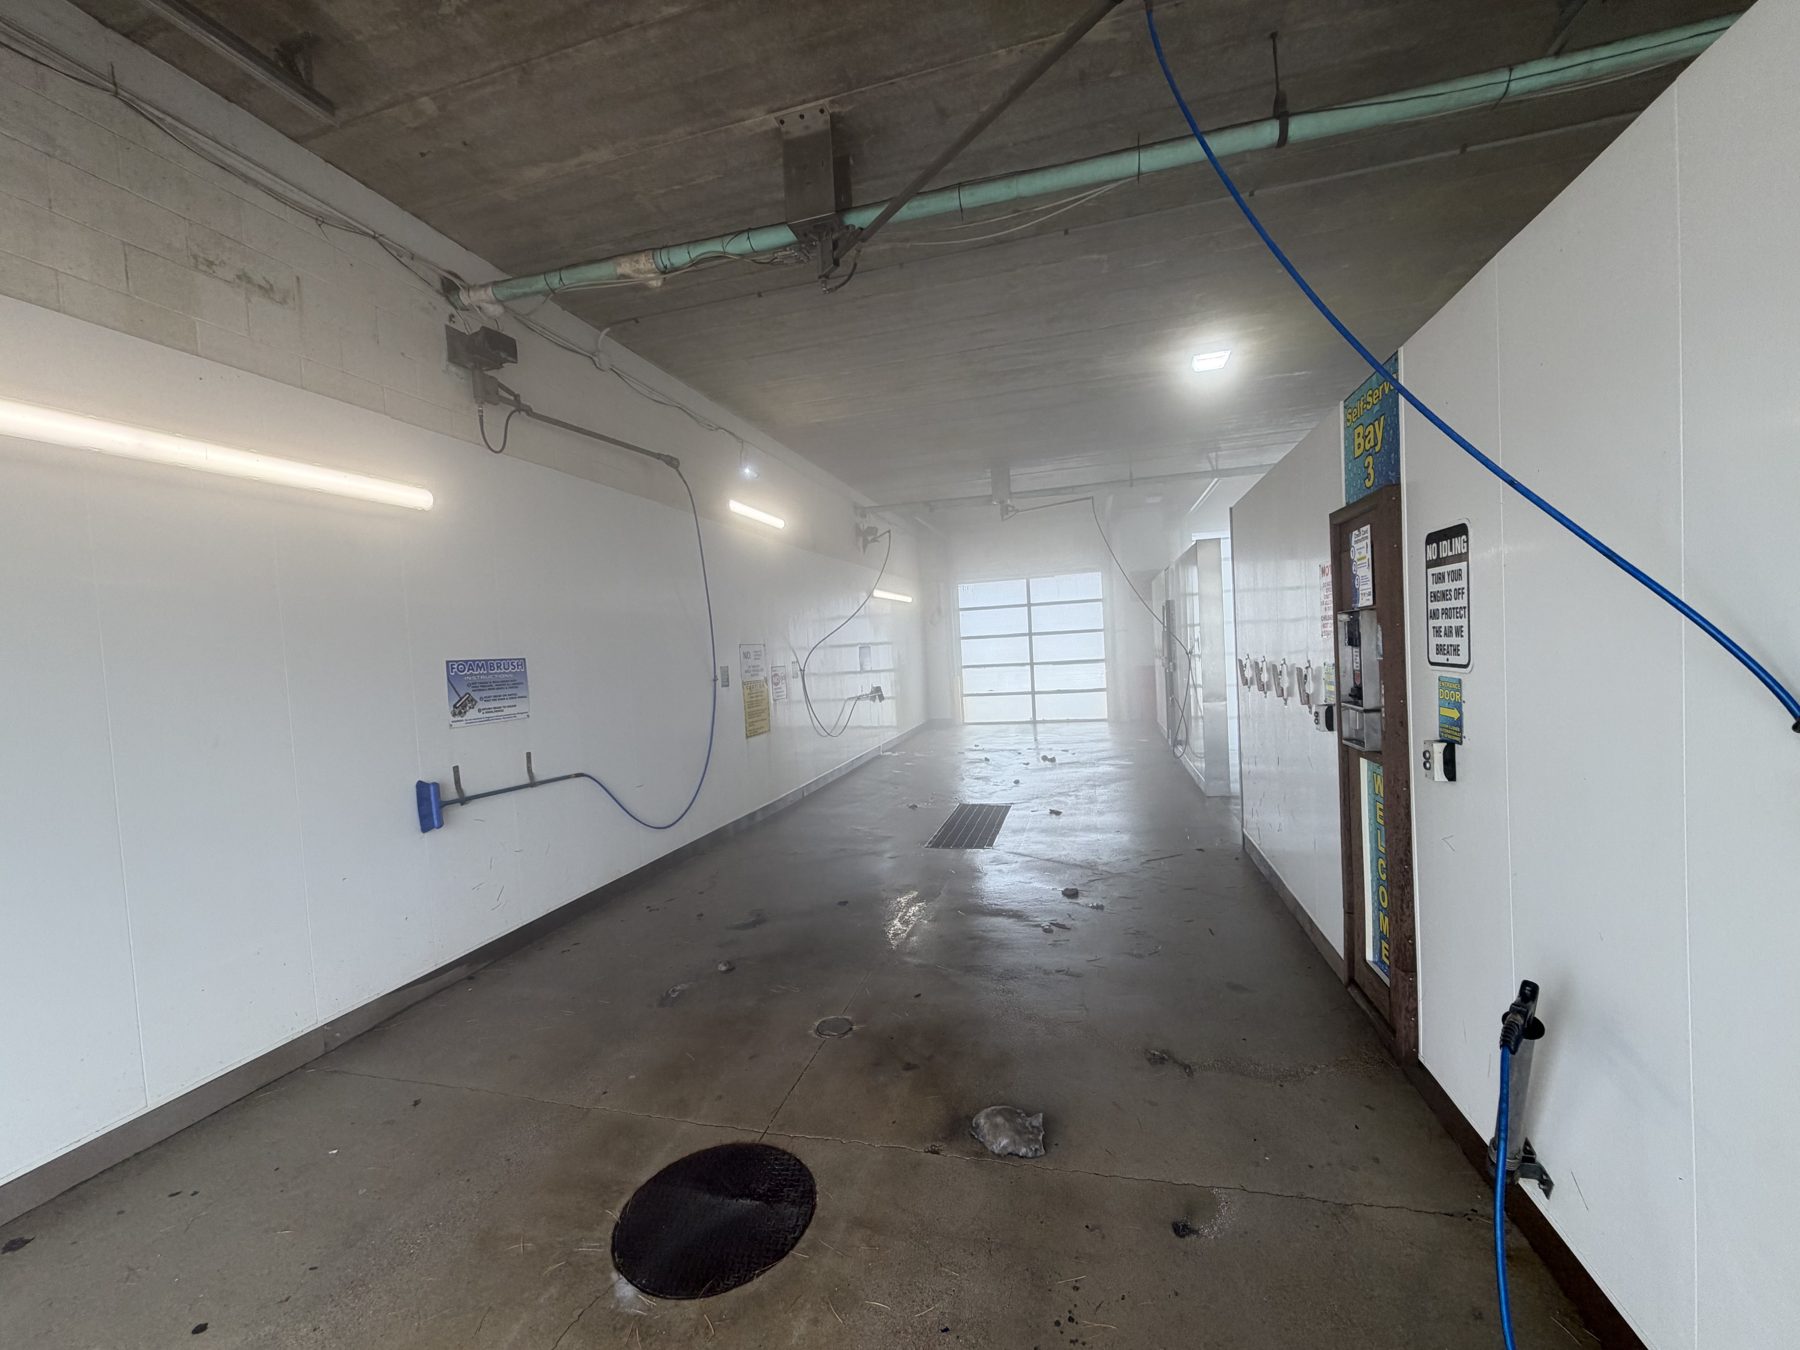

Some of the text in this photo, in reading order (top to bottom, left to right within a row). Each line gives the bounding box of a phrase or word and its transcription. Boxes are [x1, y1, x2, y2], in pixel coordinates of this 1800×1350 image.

[1354, 414, 1385, 459] Bay
[1363, 455, 1375, 489] 3
[1426, 535, 1467, 561] NO IDLING
[1431, 569, 1463, 585] TURN YOUR
[1430, 587, 1465, 603] ENGINES OFF
[1429, 606, 1466, 621] AND PROTECT
[1432, 625, 1464, 638] THE AIR WE
[1435, 644, 1460, 657] BREATHE
[449, 660, 525, 675] FOAM BRUSH
[1439, 688, 1461, 703] DOOR
[1372, 771, 1391, 966] WELCOME
